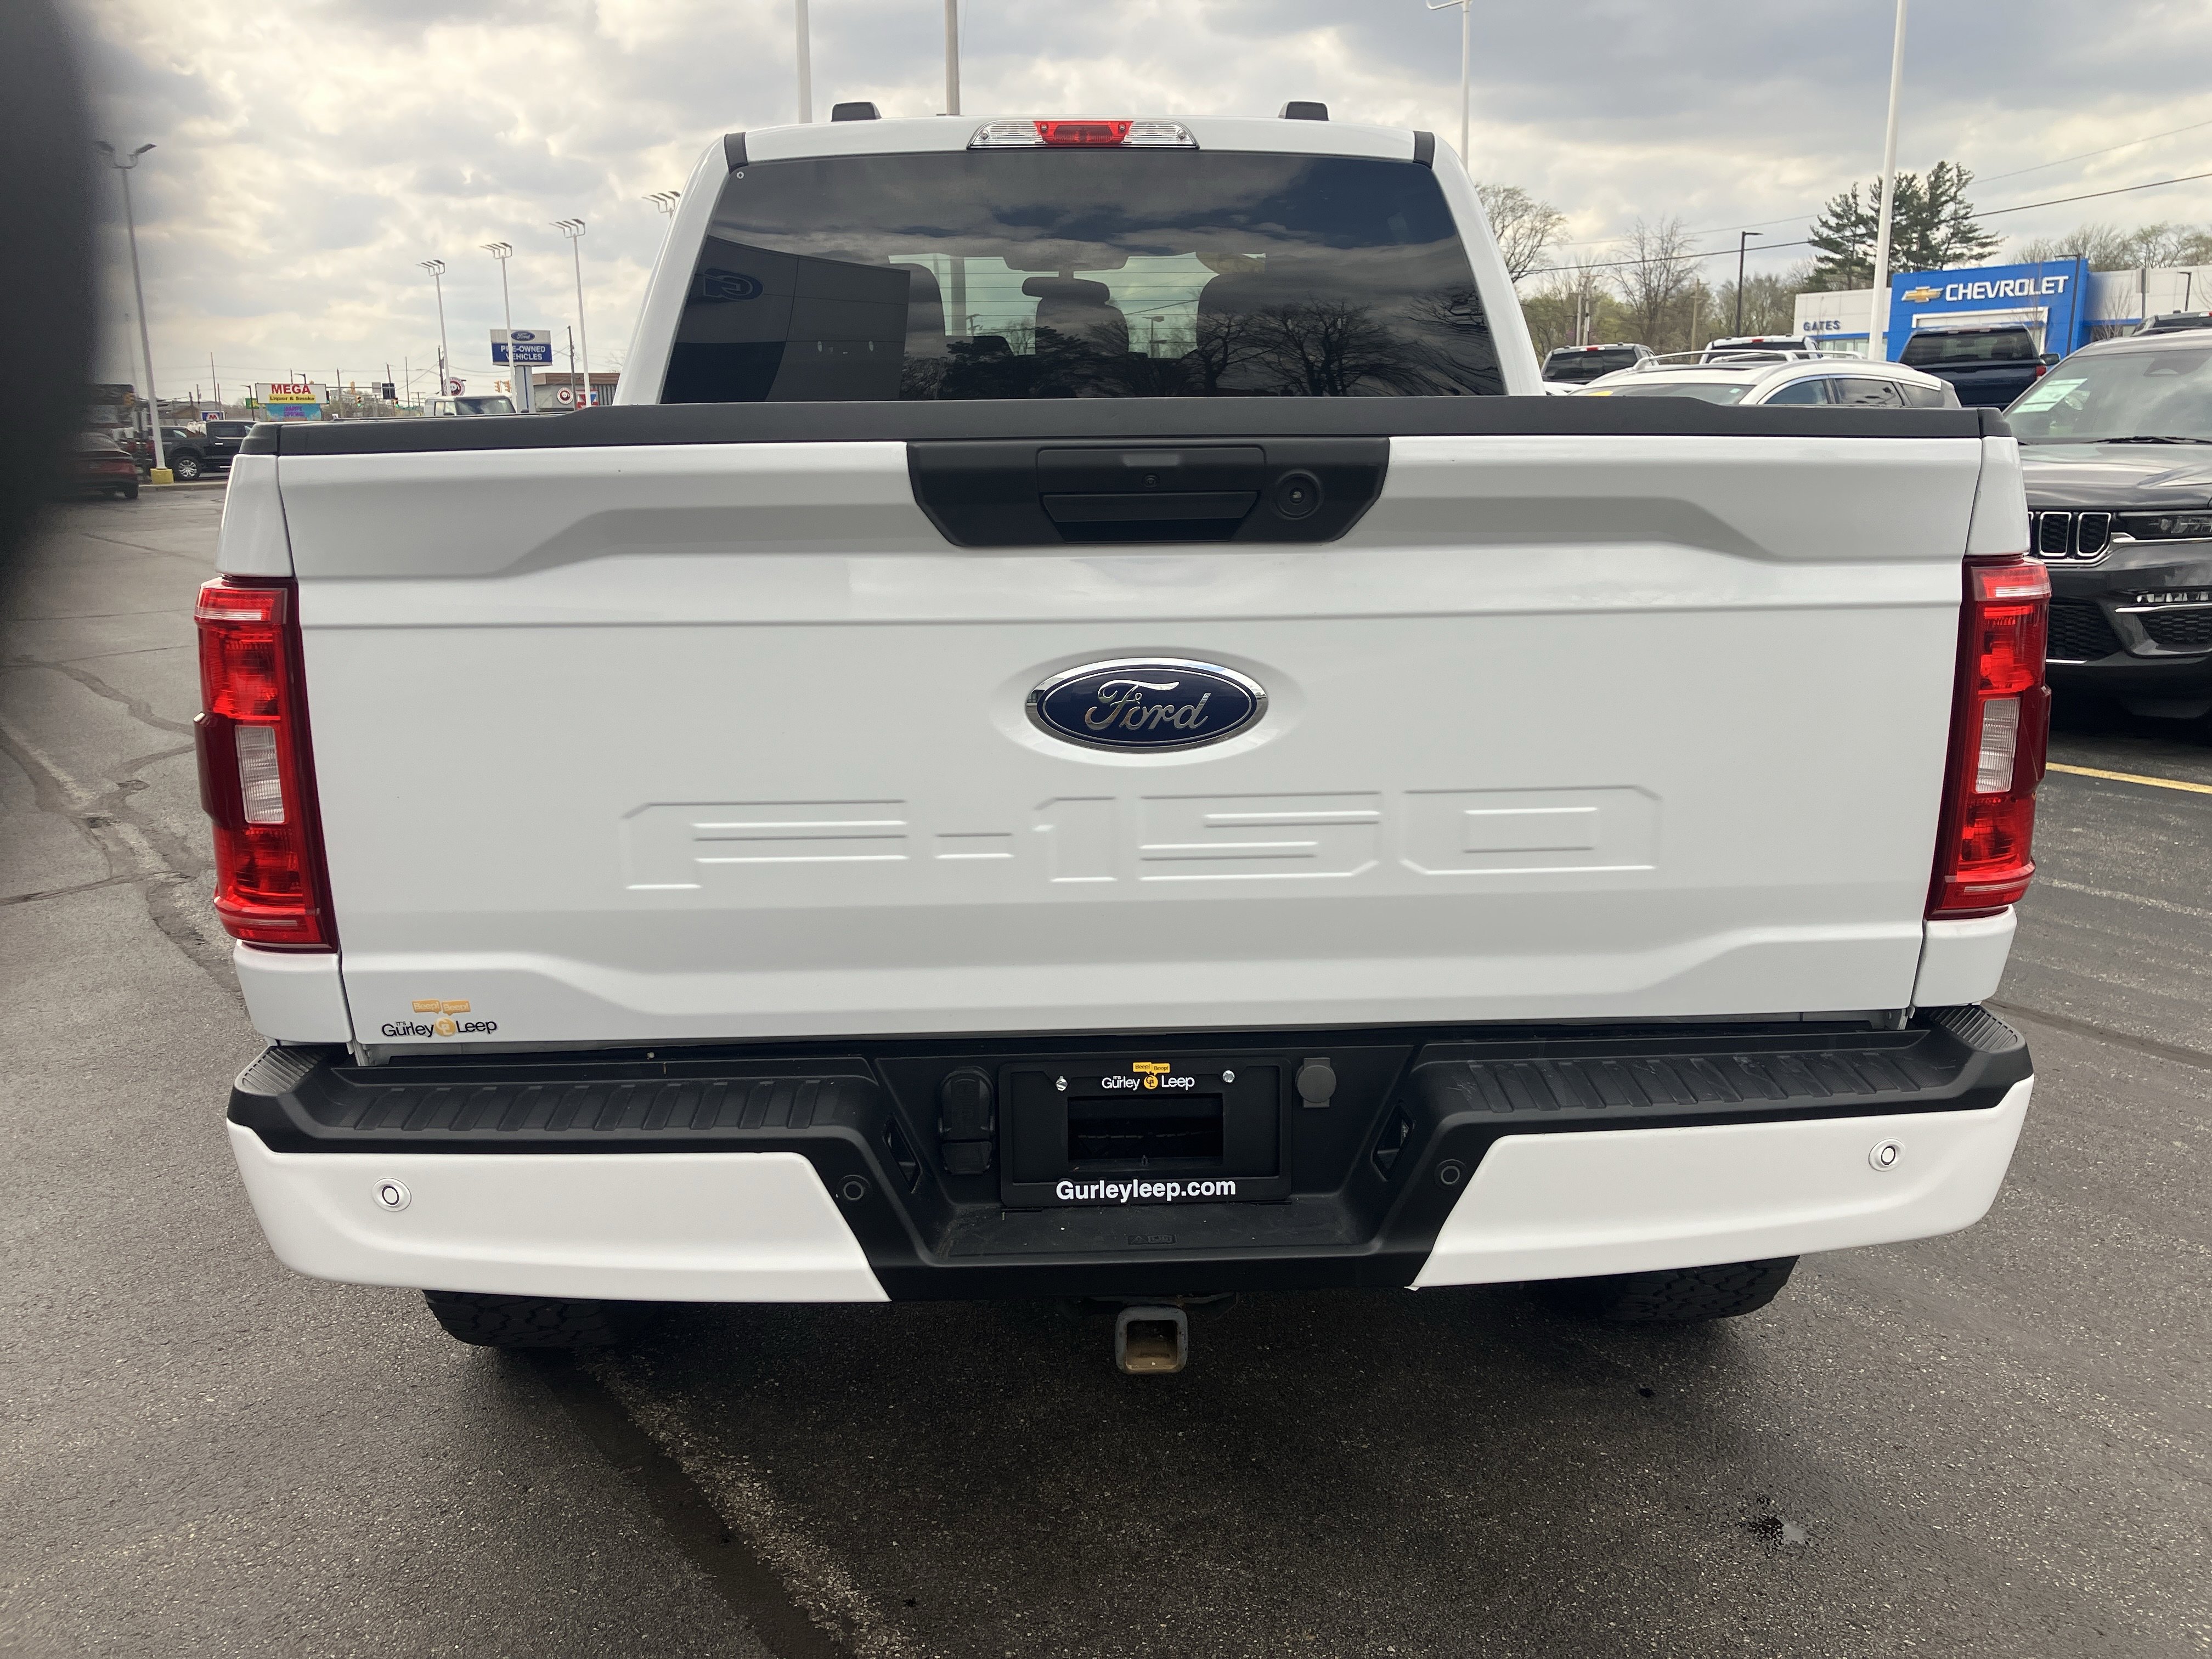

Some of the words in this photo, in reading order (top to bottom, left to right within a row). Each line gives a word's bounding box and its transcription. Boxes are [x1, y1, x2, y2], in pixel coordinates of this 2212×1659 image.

[1945, 275, 2069, 302] CHEVROLET
[1803, 320, 1841, 331] GATES
[271, 384, 312, 394] MEGA
[1085, 679, 1211, 730] Ford
[619, 786, 1663, 890] F-150
[382, 1022, 435, 1037] Gurley
[456, 1020, 497, 1034] Leep
[1102, 1076, 1141, 1091] Gurley
[1161, 1075, 1195, 1090] Leep
[1056, 1179, 1237, 1203] Gurleyleep.com
